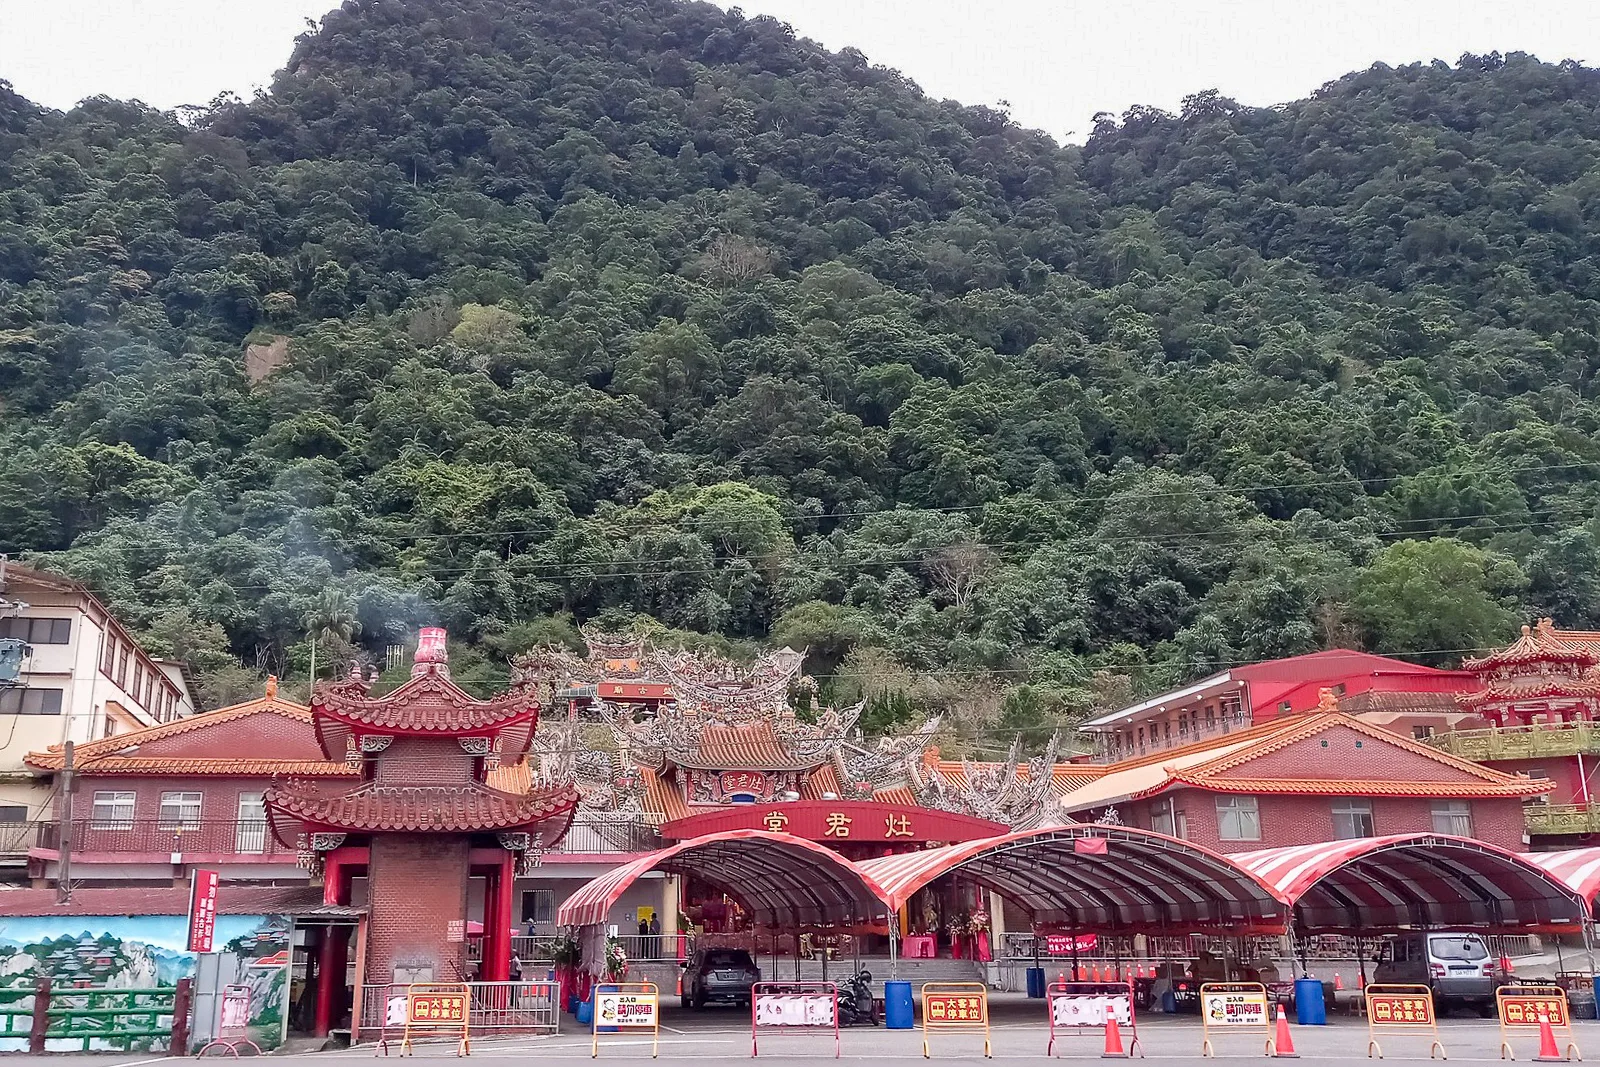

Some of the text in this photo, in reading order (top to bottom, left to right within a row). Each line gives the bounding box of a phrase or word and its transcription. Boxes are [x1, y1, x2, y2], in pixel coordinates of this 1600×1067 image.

[430, 998, 461, 1008] 大客車
[947, 998, 978, 1008] 大客車
[1392, 1000, 1425, 1011] 大客車
[430, 1008, 461, 1018] 停車位
[618, 1004, 652, 1017] 請勿停車
[947, 1008, 979, 1019] 停車位
[1226, 1004, 1262, 1017] 請勿停車
[1393, 1011, 1427, 1021] 停車位
[1525, 1012, 1560, 1022] 停位
